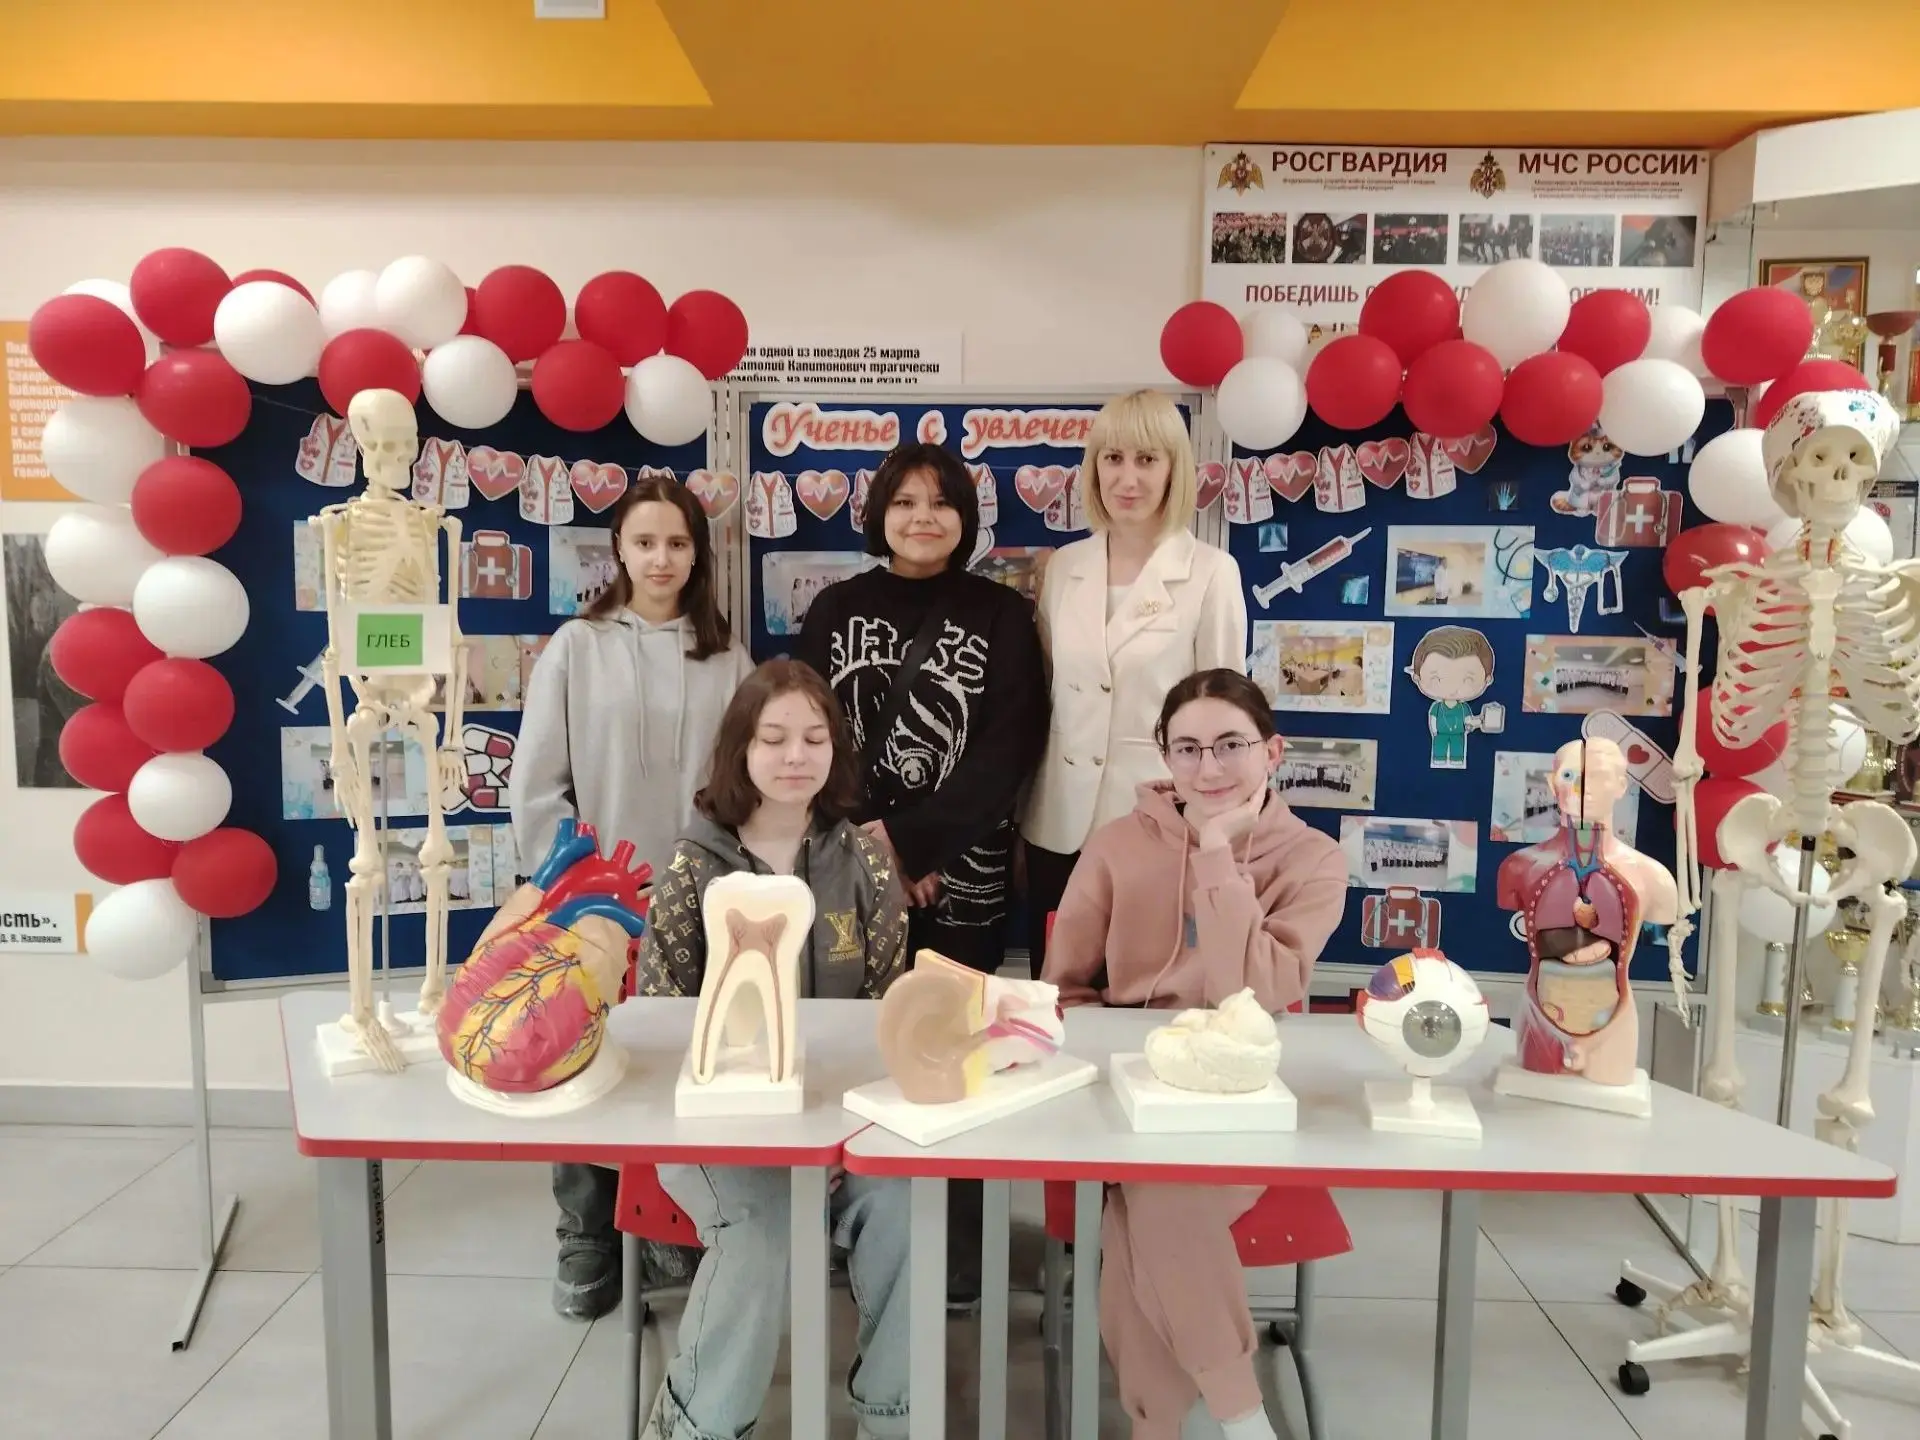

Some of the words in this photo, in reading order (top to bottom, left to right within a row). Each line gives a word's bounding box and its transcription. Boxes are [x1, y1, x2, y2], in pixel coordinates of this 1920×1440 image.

[1272, 151, 1448, 178] РОСГВАРДИЯ
[1518, 153, 1579, 175] МЧС
[1586, 153, 1699, 175] РОССИИ
[1245, 284, 1359, 306] ПОБЕДИШЬ
[760, 345, 794, 358] одной
[797, 347, 810, 358] из
[813, 347, 860, 359] поездок
[863, 346, 877, 358] 25
[880, 348, 920, 361] марта
[788, 360, 866, 373] Капитонович
[870, 362, 940, 375] трагически
[771, 409, 897, 448] Ученье
[923, 415, 939, 440] с
[962, 414, 1096, 451] увлечен
[366, 633, 411, 649] ГЛЕБ
